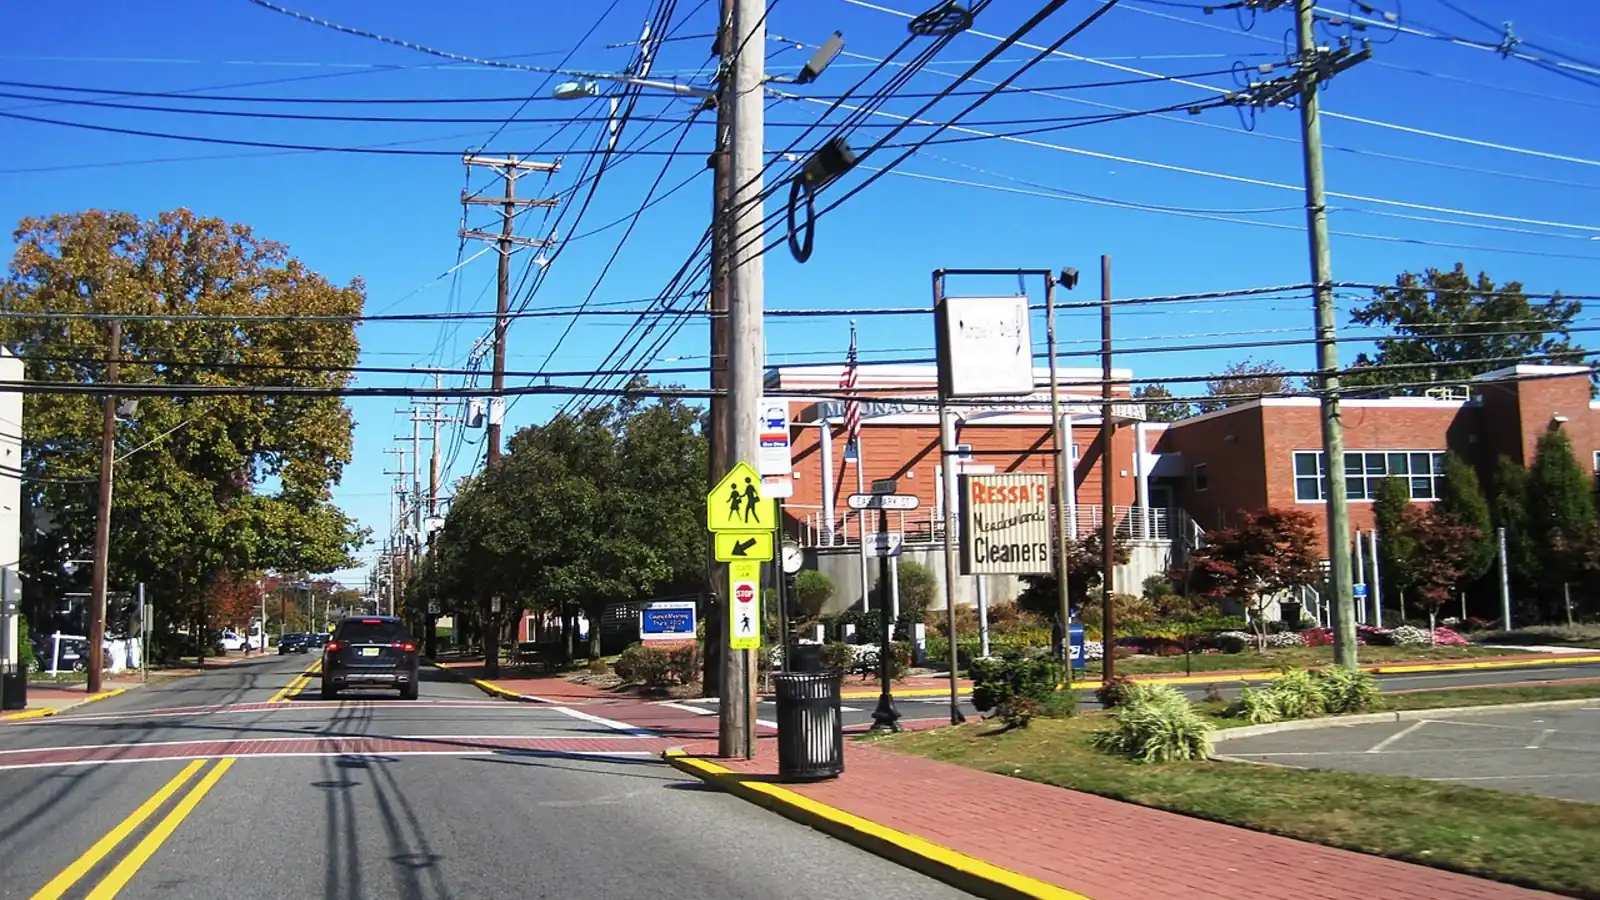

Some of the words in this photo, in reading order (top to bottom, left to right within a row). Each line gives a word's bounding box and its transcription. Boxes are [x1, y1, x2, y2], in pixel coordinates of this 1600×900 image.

[826, 397, 951, 415] MONACHIE
[971, 481, 1045, 504] RESSA'S
[974, 536, 1047, 564] Cleaners
[736, 590, 754, 598] STOP
